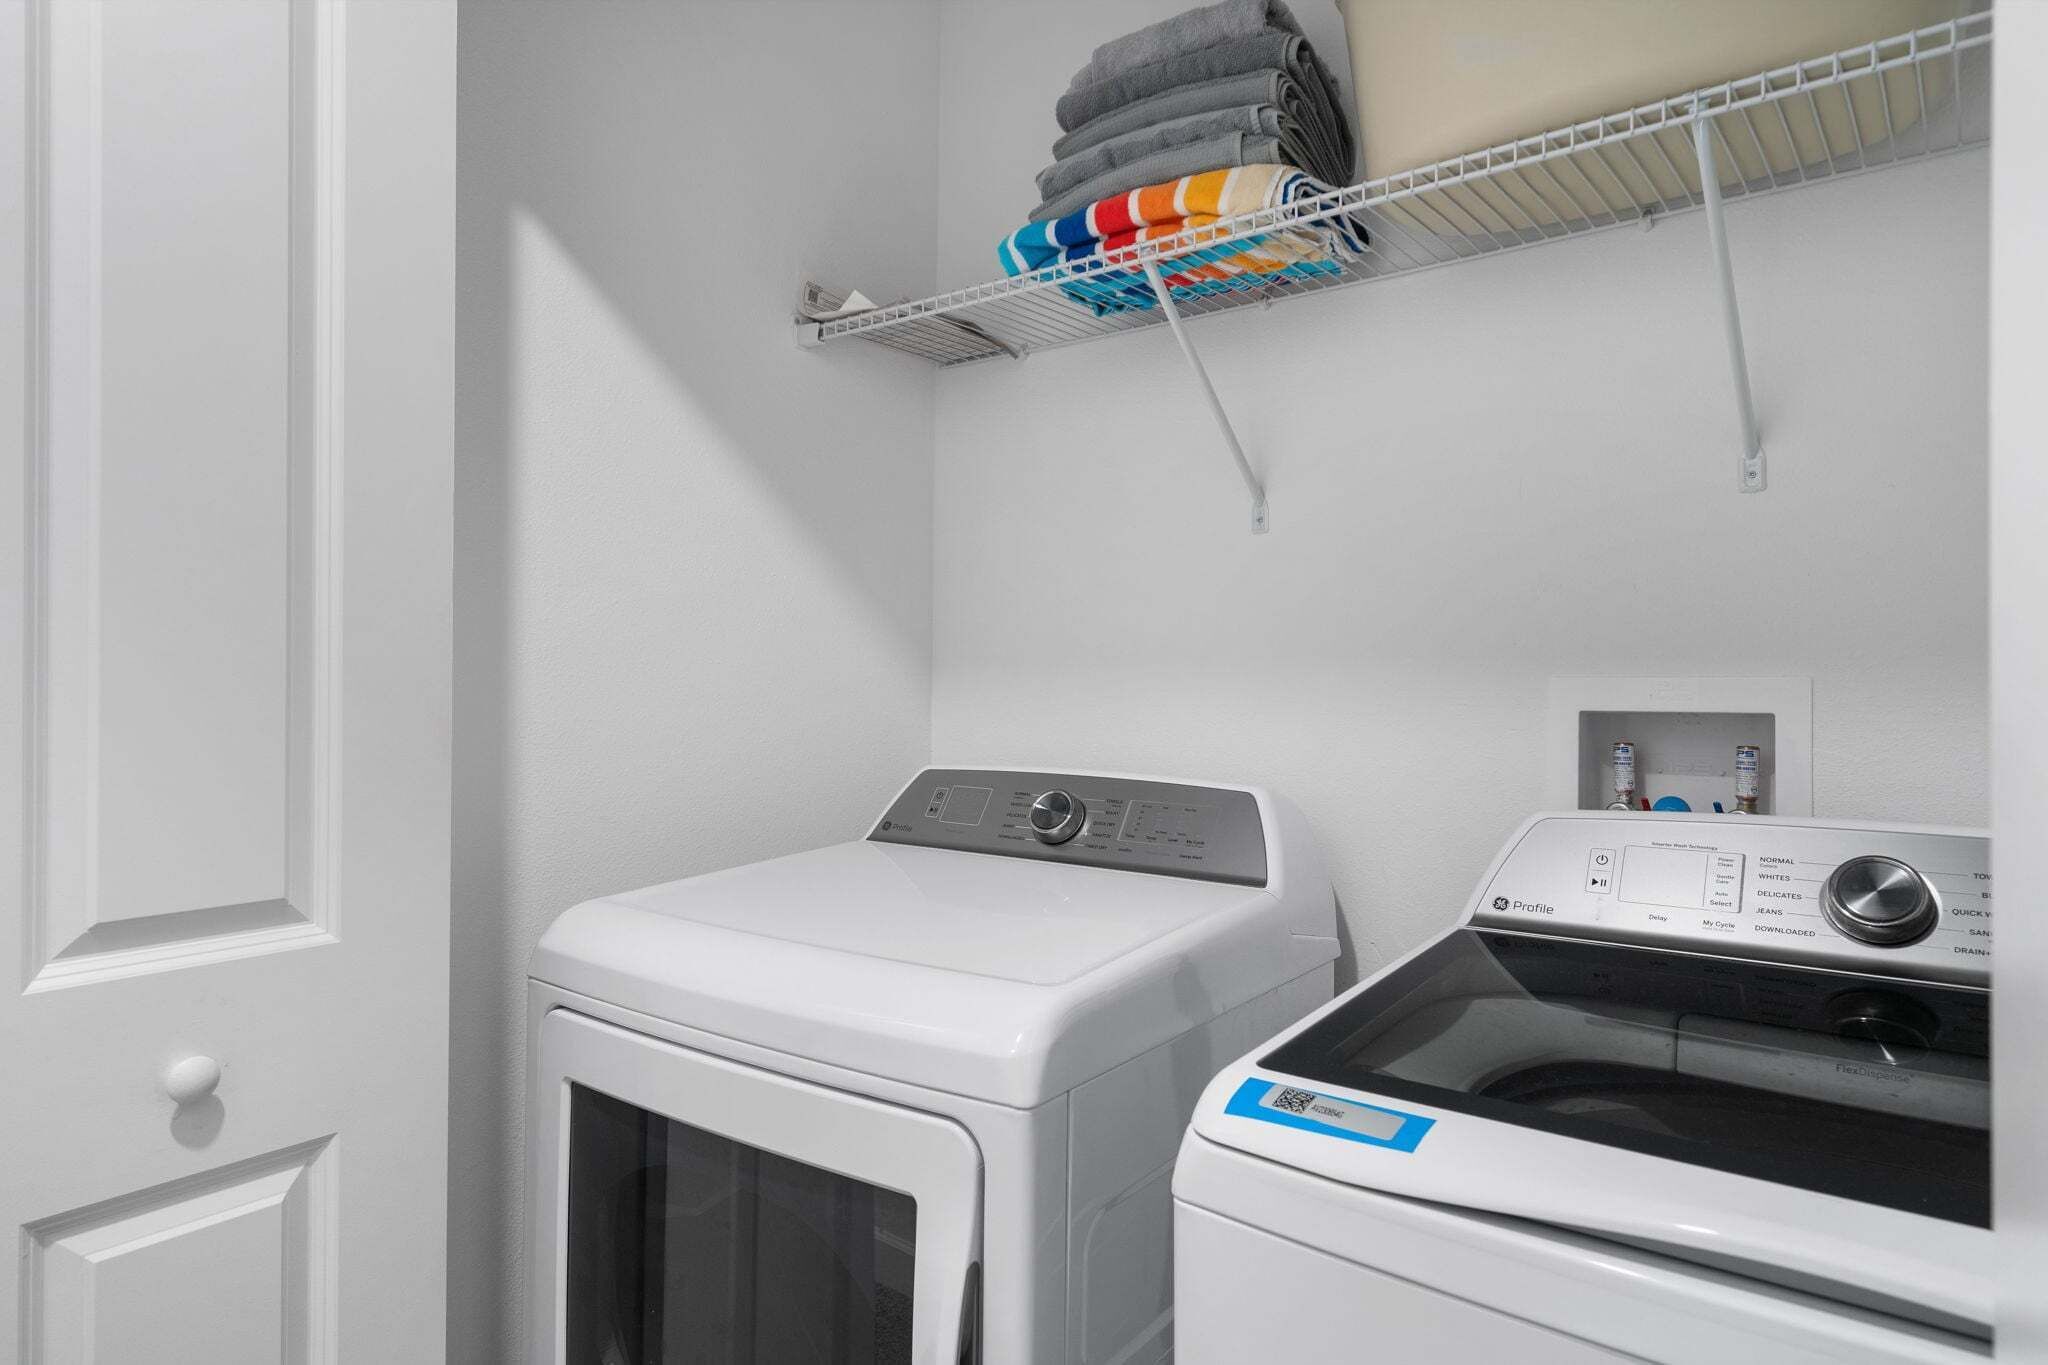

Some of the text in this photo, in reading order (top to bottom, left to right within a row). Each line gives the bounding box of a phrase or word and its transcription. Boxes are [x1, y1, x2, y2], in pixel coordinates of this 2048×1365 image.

[1759, 856, 1795, 865] NORMAL
[1758, 873, 1791, 882] WHITES
[1757, 890, 1803, 900] DELICATES
[1512, 900, 1554, 915] Profile
[1709, 899, 1732, 907] Select
[1755, 907, 1783, 916] JEANS
[1952, 908, 1983, 918] QUICK
[1648, 914, 1668, 922] Delay
[1702, 919, 1714, 927] My
[1715, 921, 1736, 929] Cycle
[1754, 924, 1816, 937] DOWNLOADED
